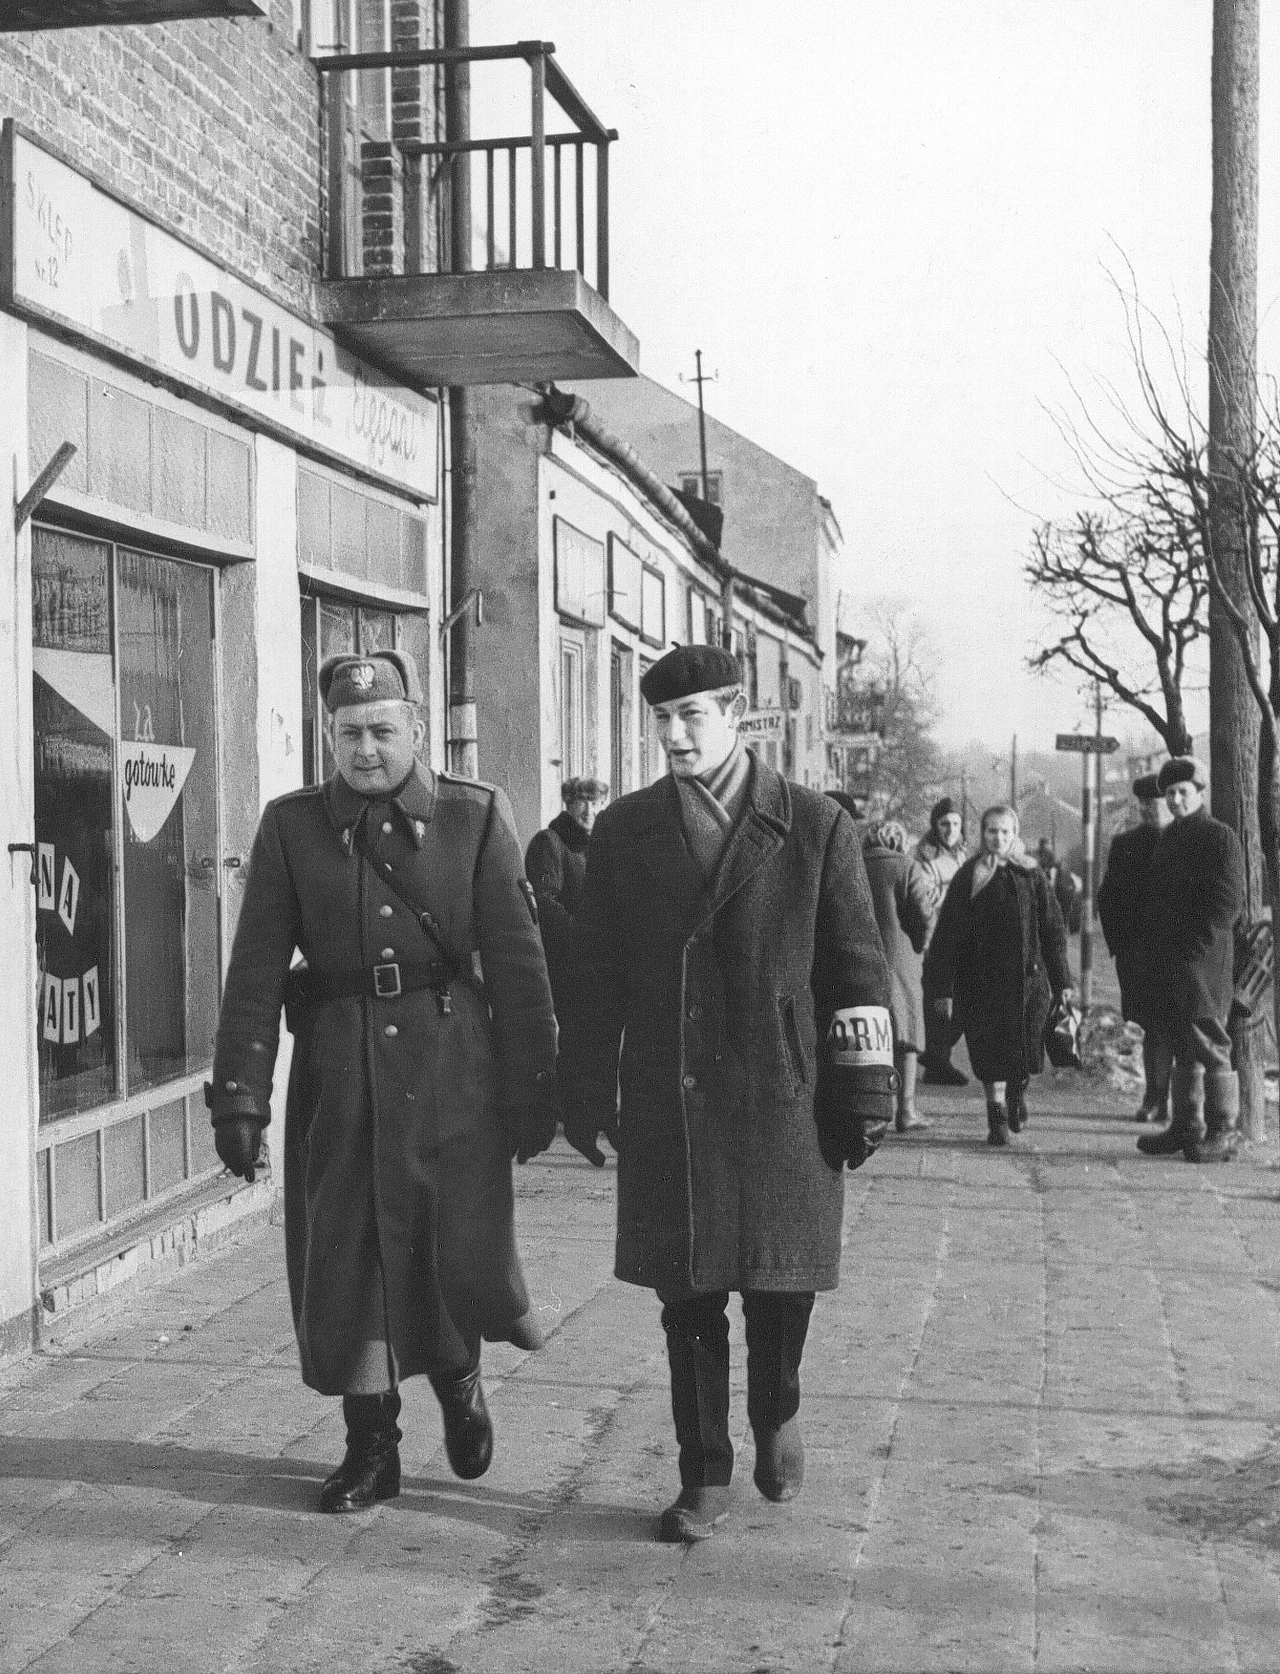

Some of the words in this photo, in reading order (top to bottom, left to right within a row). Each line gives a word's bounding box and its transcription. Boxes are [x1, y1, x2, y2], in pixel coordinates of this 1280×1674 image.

[738, 716, 780, 733] RMISTRZ
[41, 852, 74, 920] NA
[45, 978, 97, 1031] ATY
[831, 1017, 891, 1052] ORM
